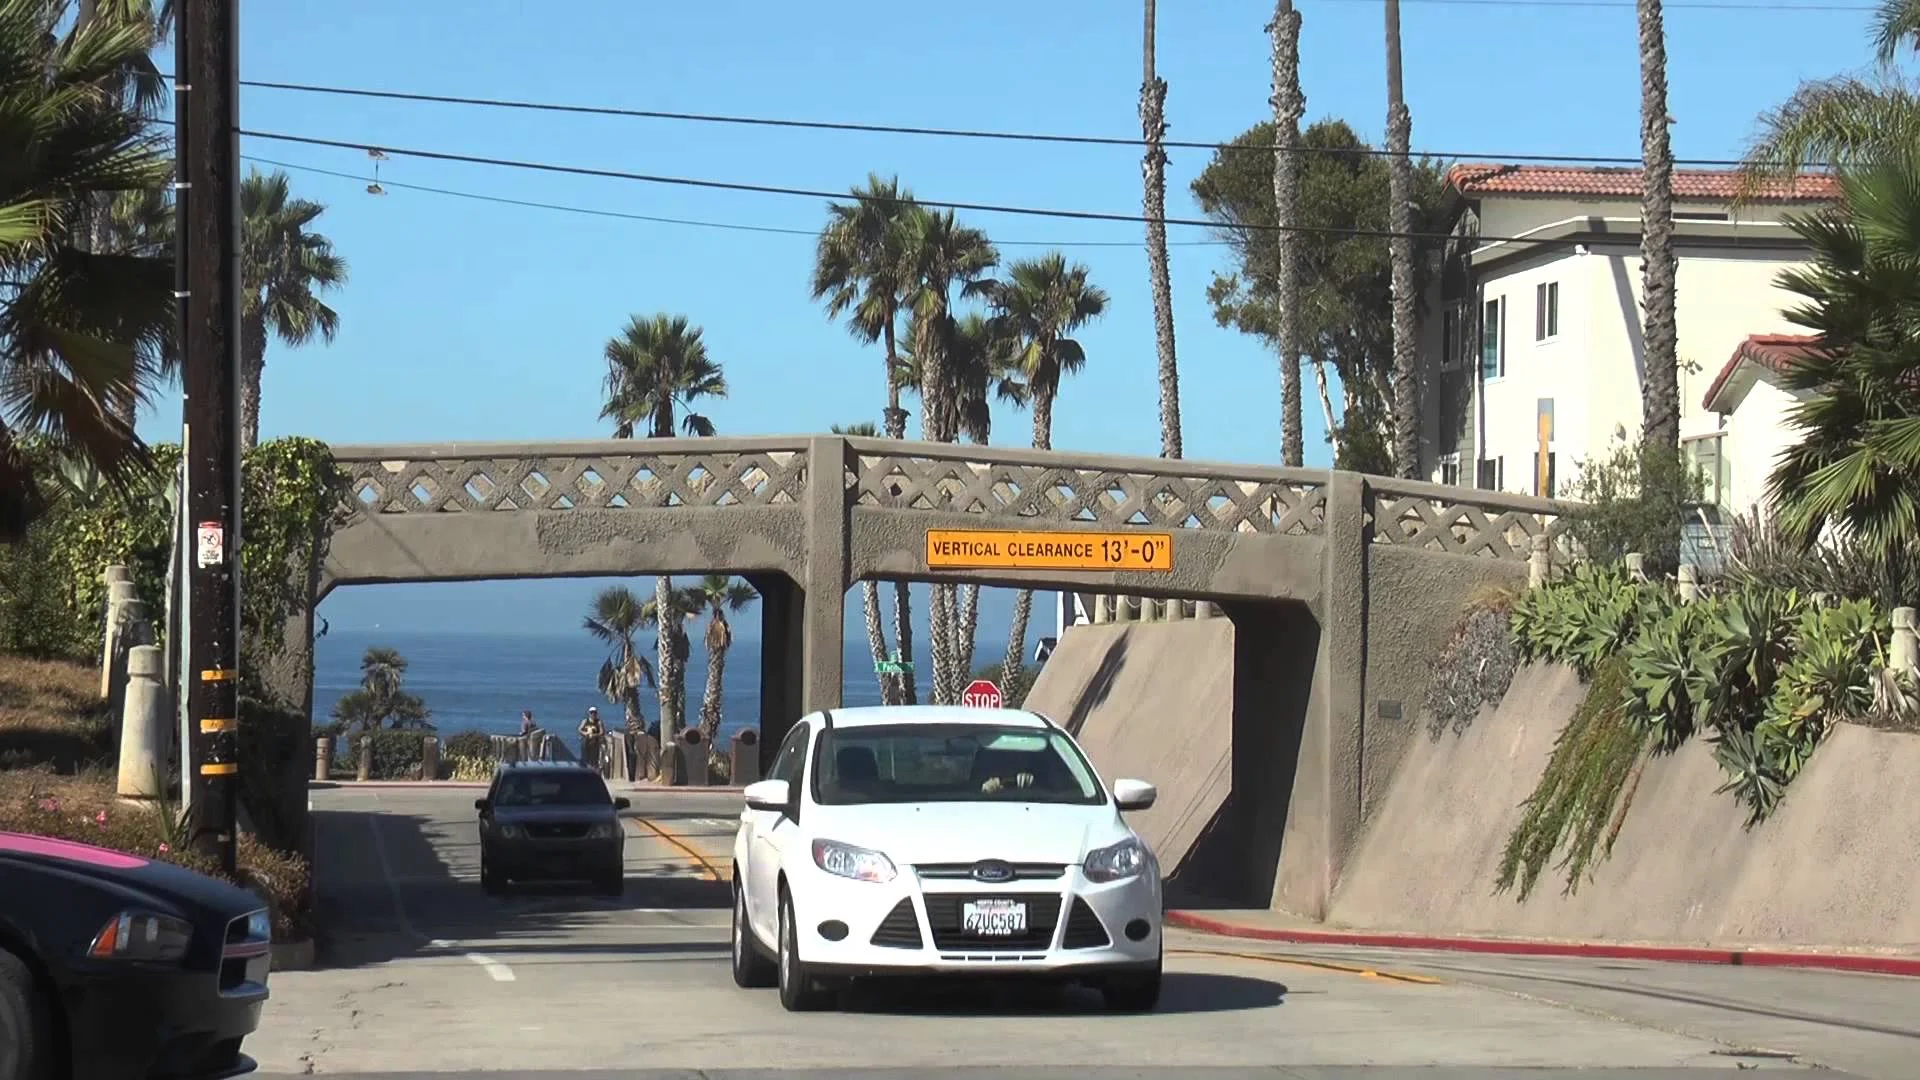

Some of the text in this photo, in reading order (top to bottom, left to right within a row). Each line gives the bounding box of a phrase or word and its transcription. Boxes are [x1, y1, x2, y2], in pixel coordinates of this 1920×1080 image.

[933, 541, 1000, 556] VERTICAL
[1008, 543, 1093, 558] CLEARANCE
[965, 692, 999, 709] STOP
[966, 912, 1023, 930] 6ZUC587
